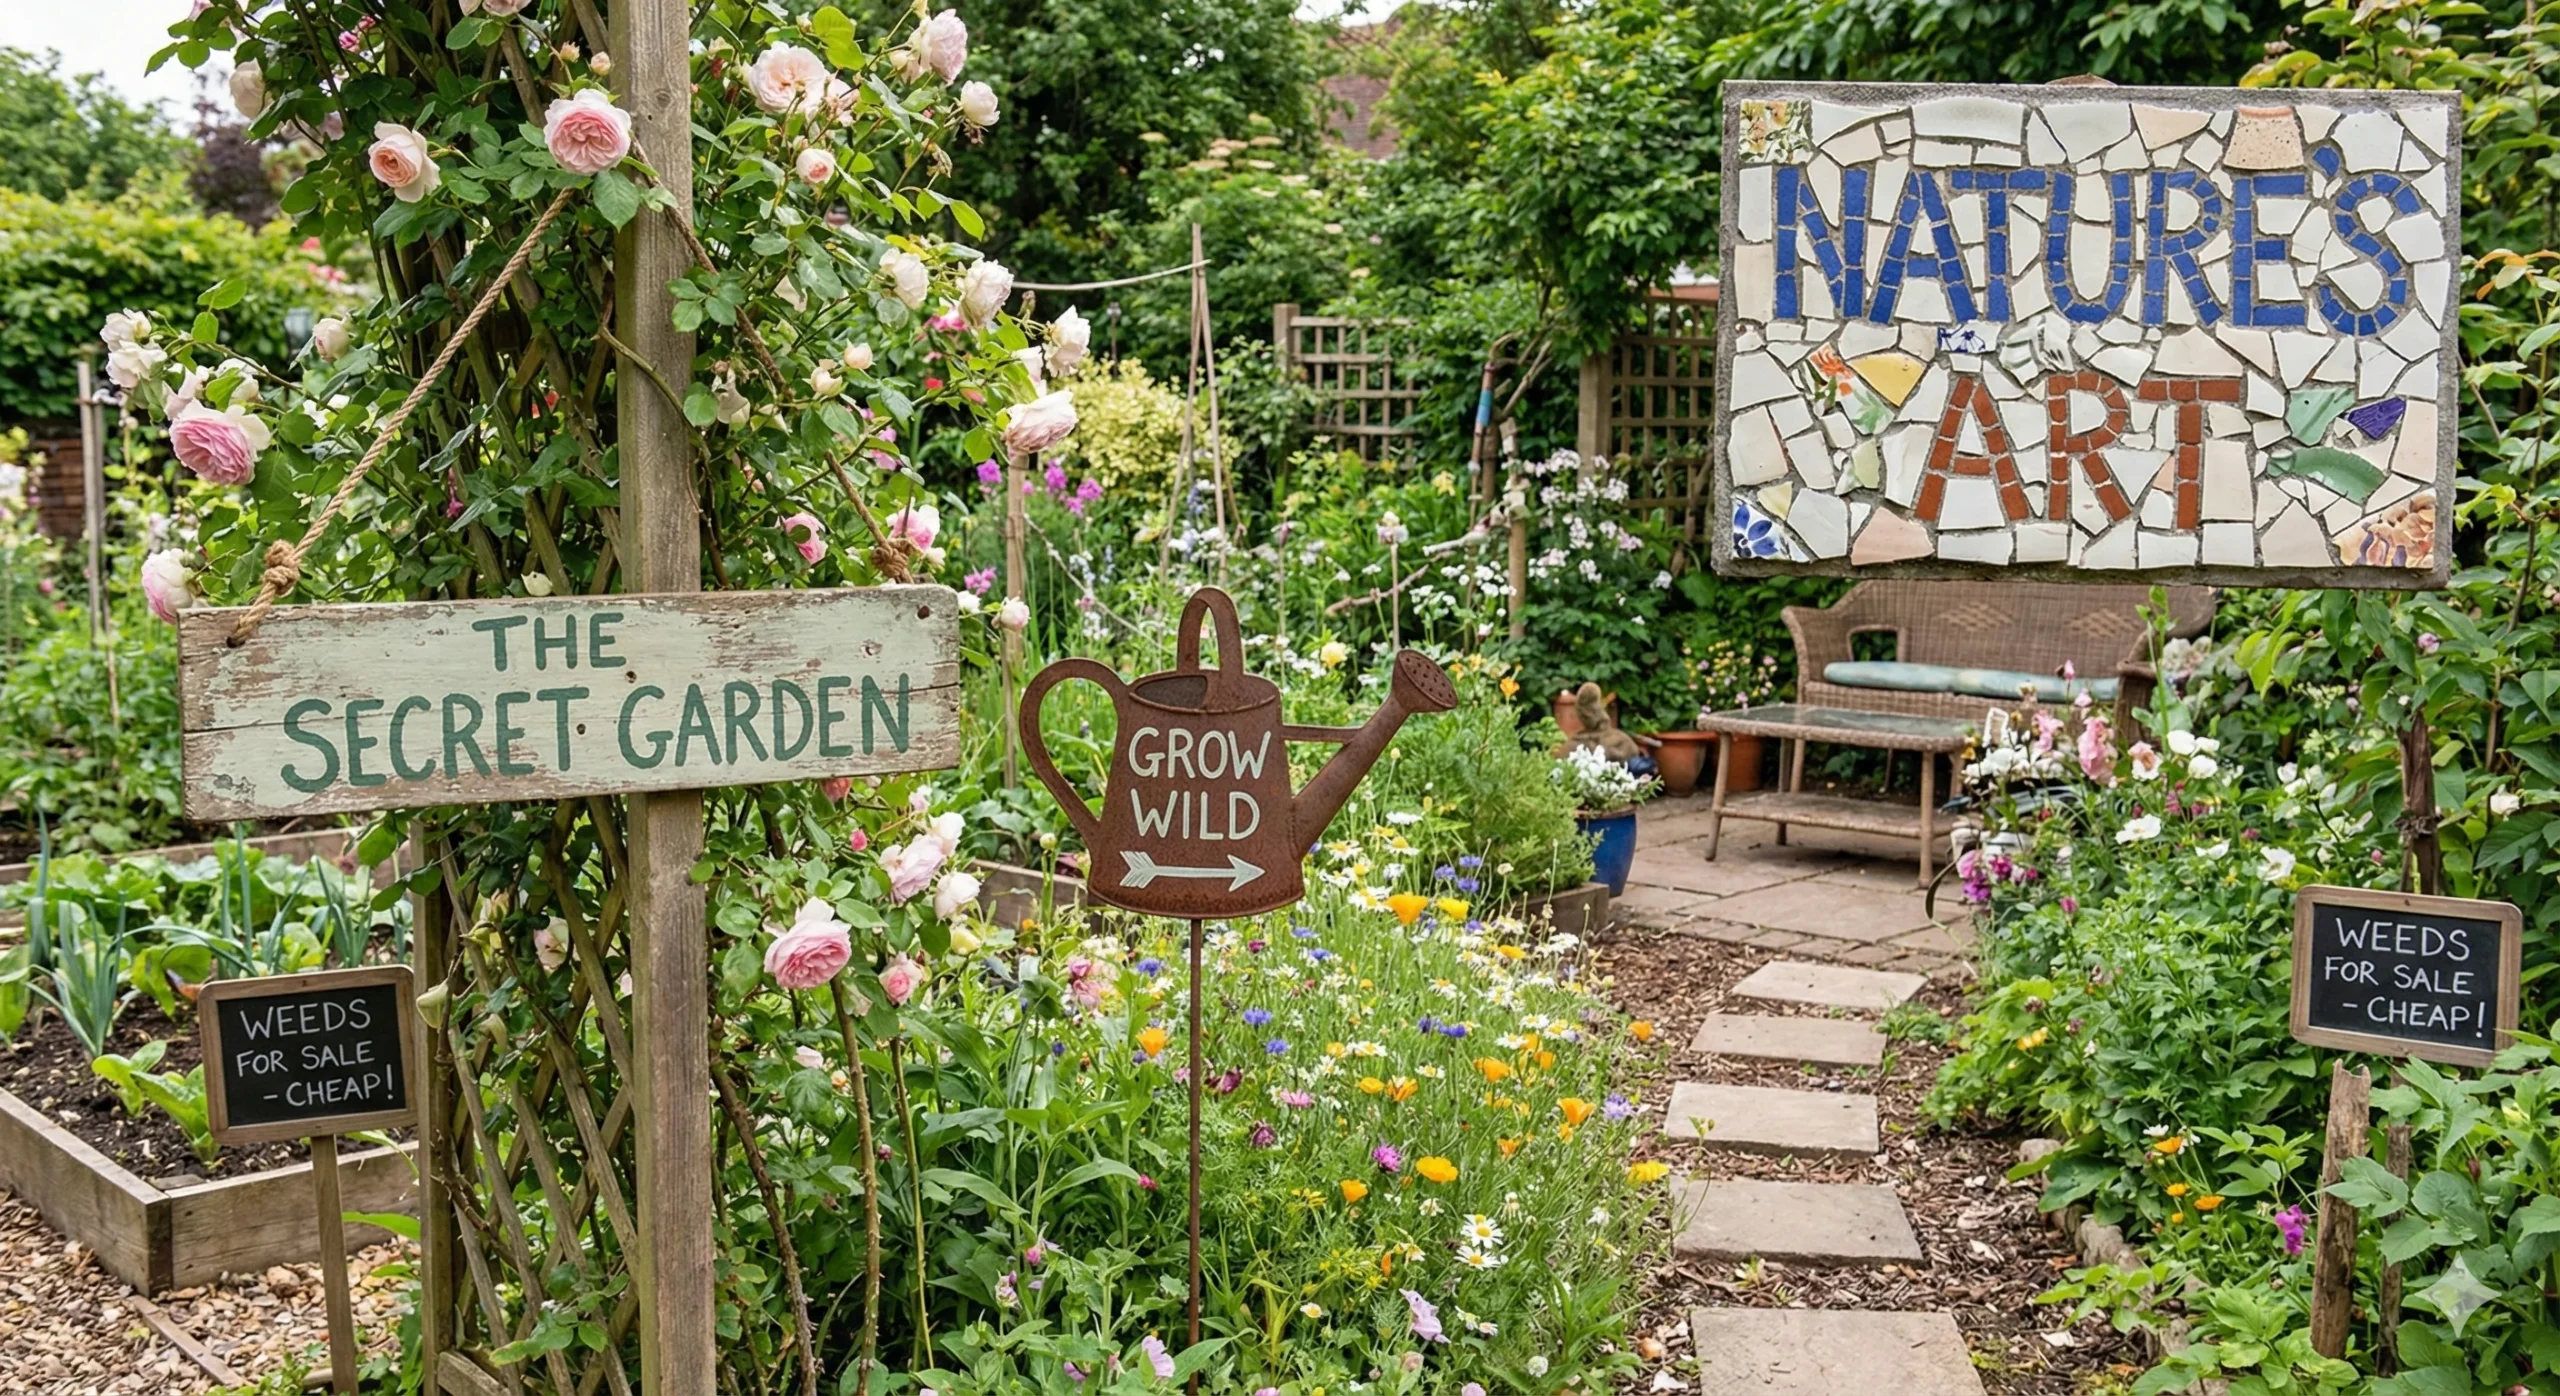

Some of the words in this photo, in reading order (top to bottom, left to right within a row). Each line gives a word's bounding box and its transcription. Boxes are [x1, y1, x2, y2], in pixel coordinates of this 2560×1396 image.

[1774, 145, 2422, 336] NATURE'S
[1915, 371, 2240, 530] ART
[471, 612, 627, 671] THE
[280, 686, 590, 792] SECRET
[618, 673, 910, 769] GARDEN
[1128, 727, 1271, 779] GROW
[1131, 788, 1260, 840] WILD
[2335, 917, 2470, 961] WEEDS
[2324, 956, 2379, 986] FOR
[2394, 964, 2474, 995] SALE
[240, 999, 371, 1040] WEEDS
[236, 1050, 288, 1077] FOR
[301, 1040, 375, 1070] SALE
